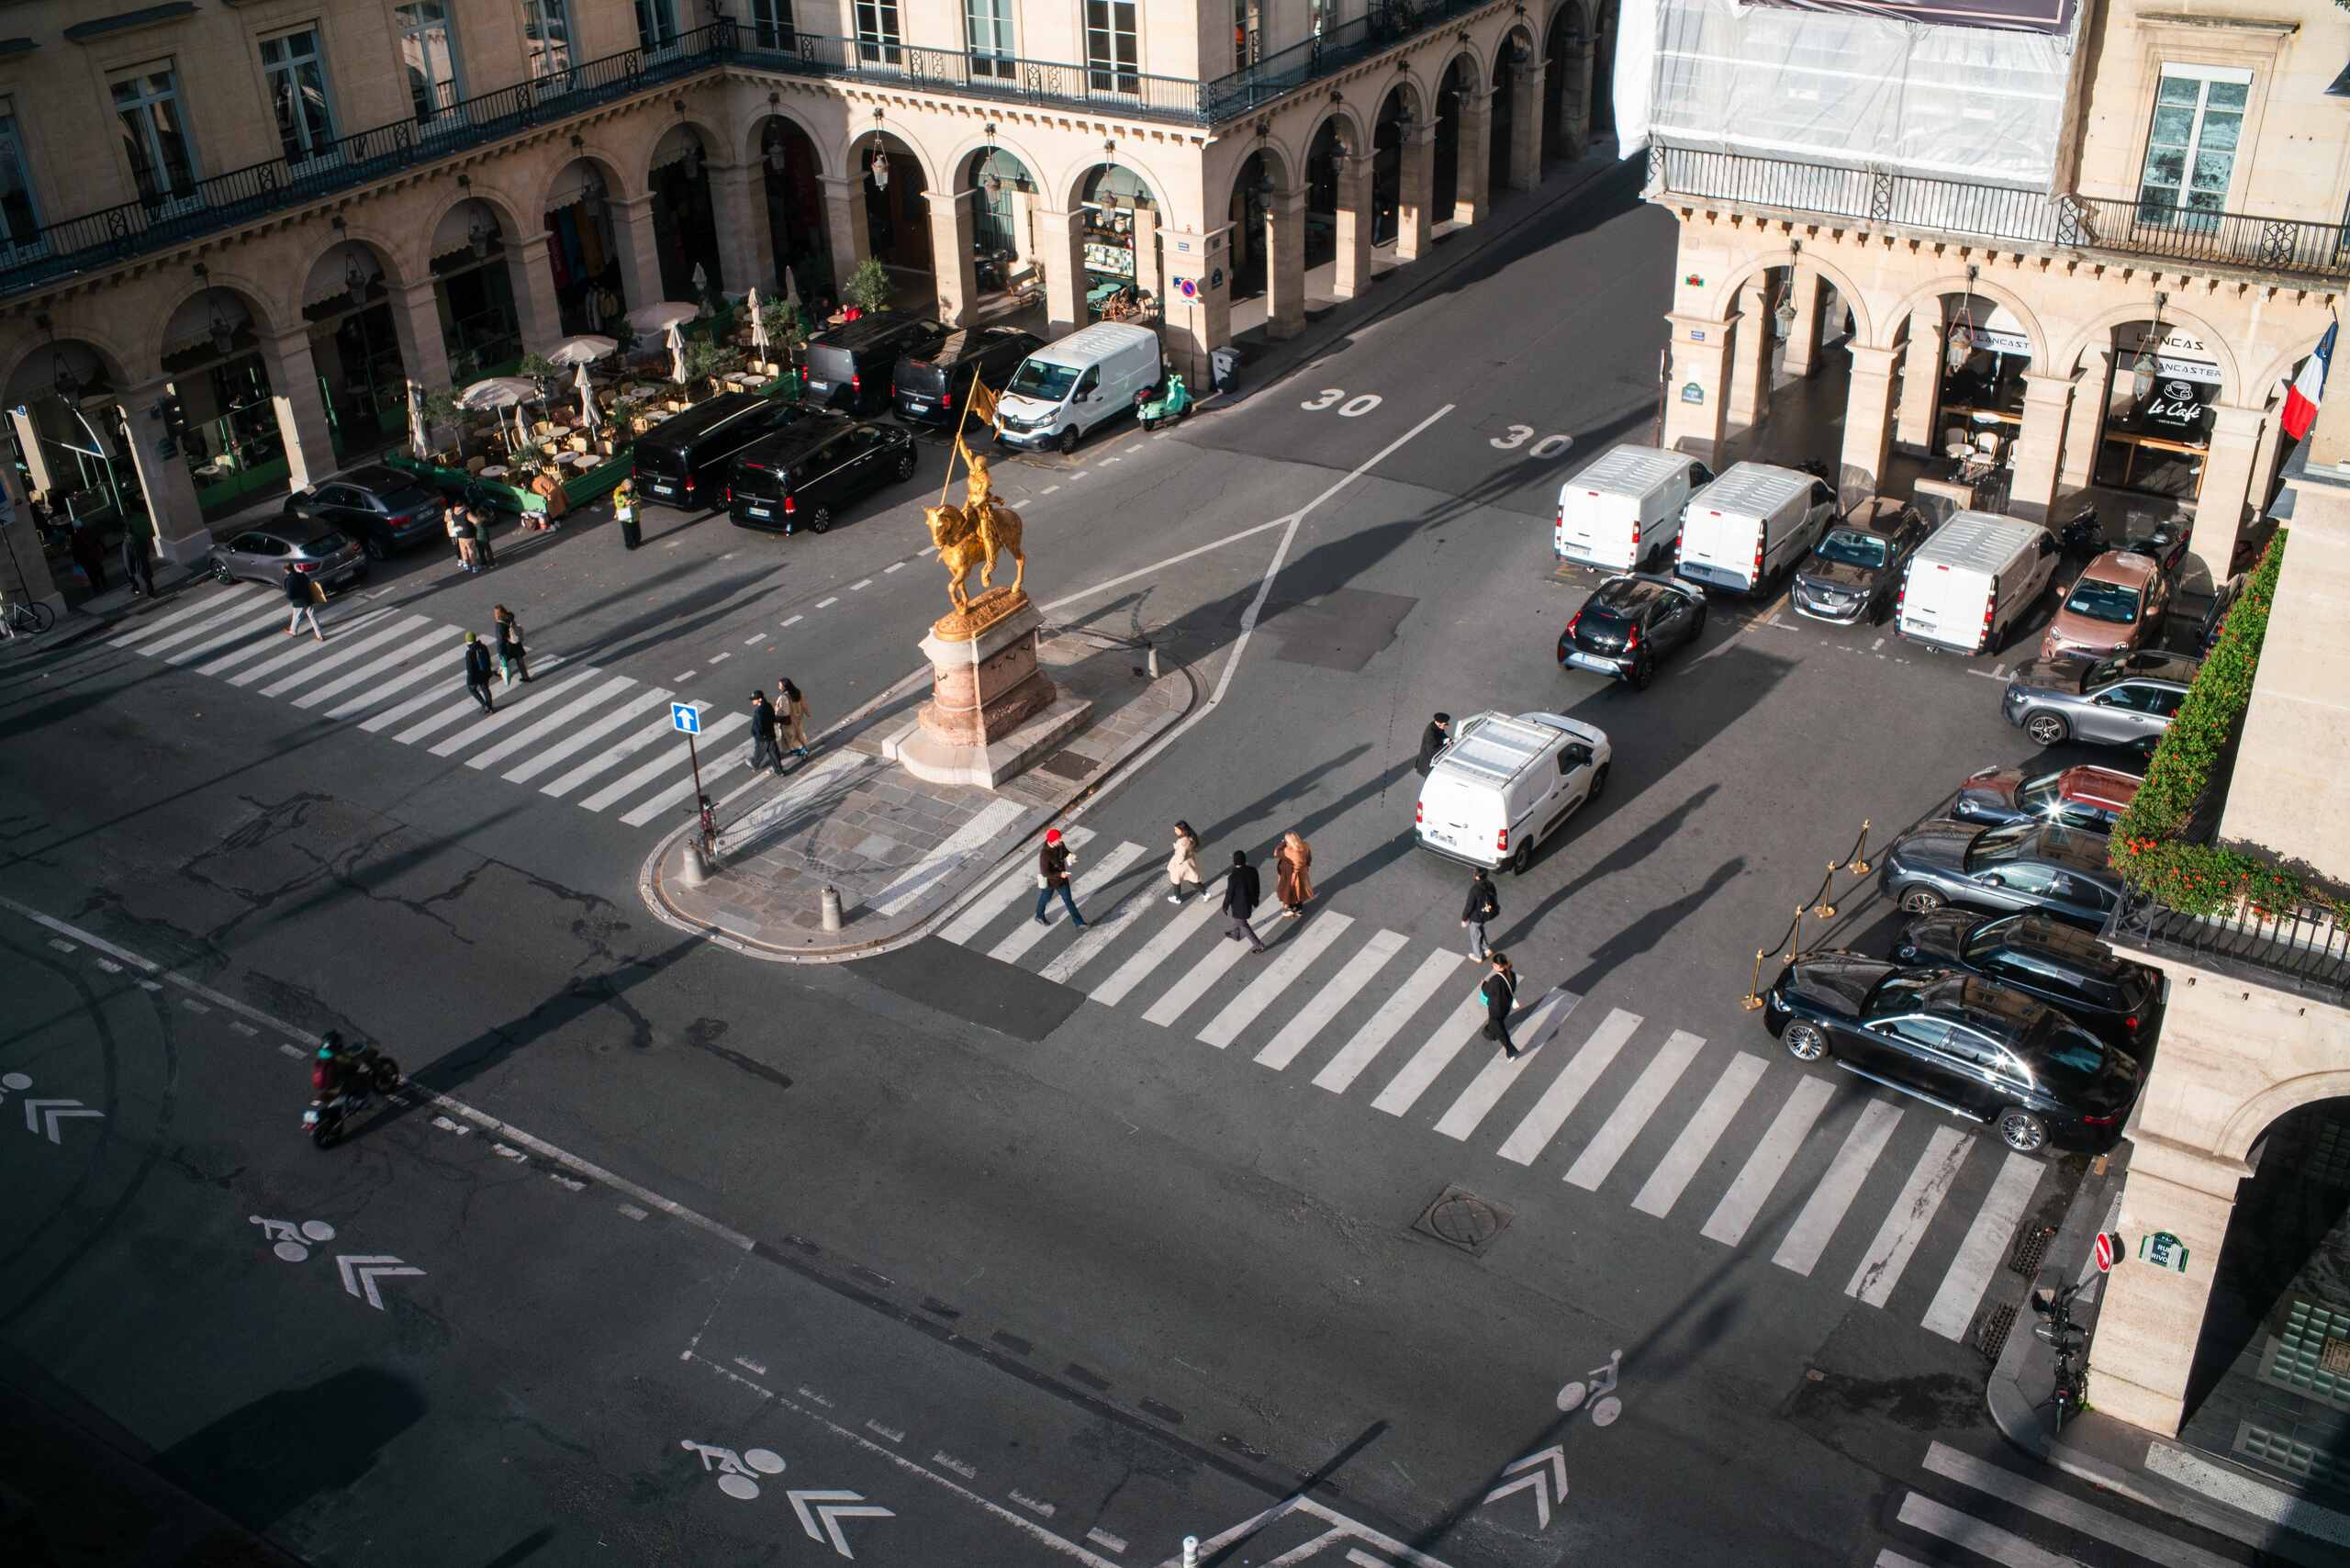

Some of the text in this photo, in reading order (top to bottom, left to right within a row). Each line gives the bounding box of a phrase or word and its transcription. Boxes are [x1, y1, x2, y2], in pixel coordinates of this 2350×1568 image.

[1301, 388, 1382, 417] 30
[2148, 398, 2201, 422] Le Café
[1490, 424, 1573, 459] 30
